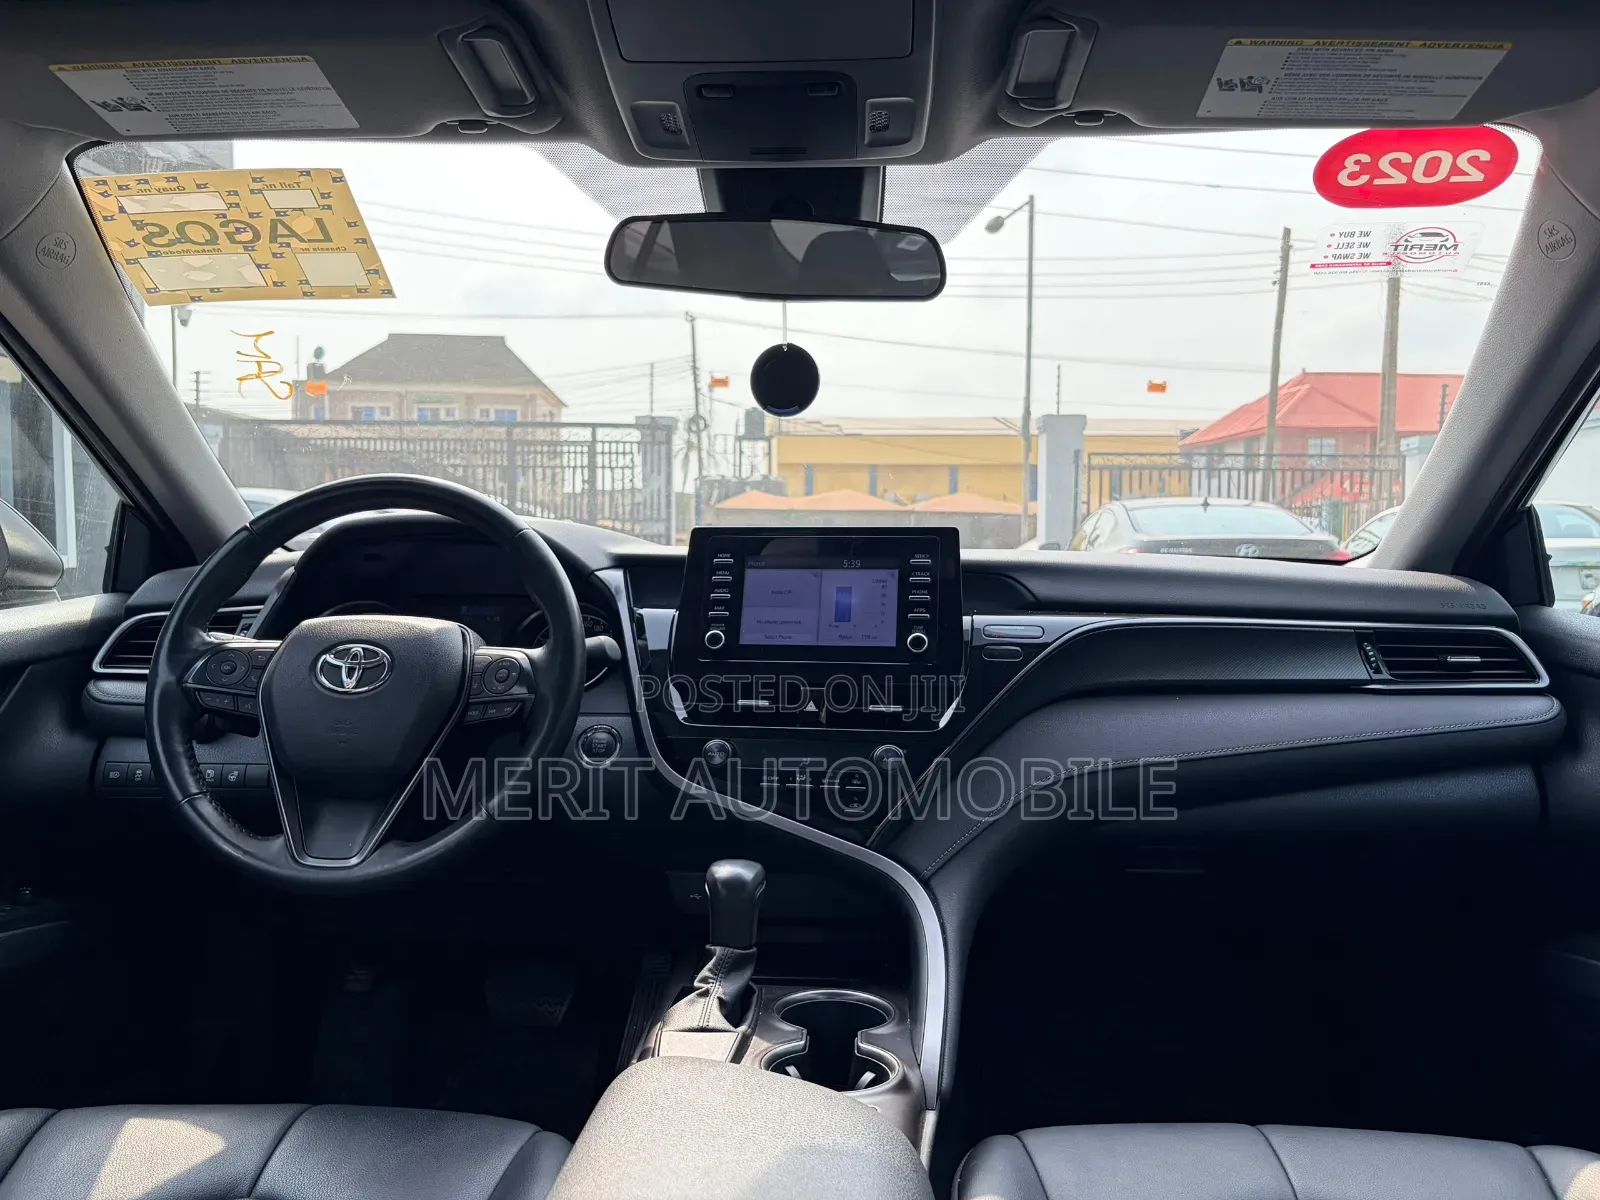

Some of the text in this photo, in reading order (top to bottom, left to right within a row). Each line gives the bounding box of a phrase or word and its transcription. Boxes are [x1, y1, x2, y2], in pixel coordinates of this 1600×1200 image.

[1313, 40, 1413, 49] AVERTISSEMENT
[52, 237, 69, 250] SRS
[843, 560, 861, 568] 5:39
